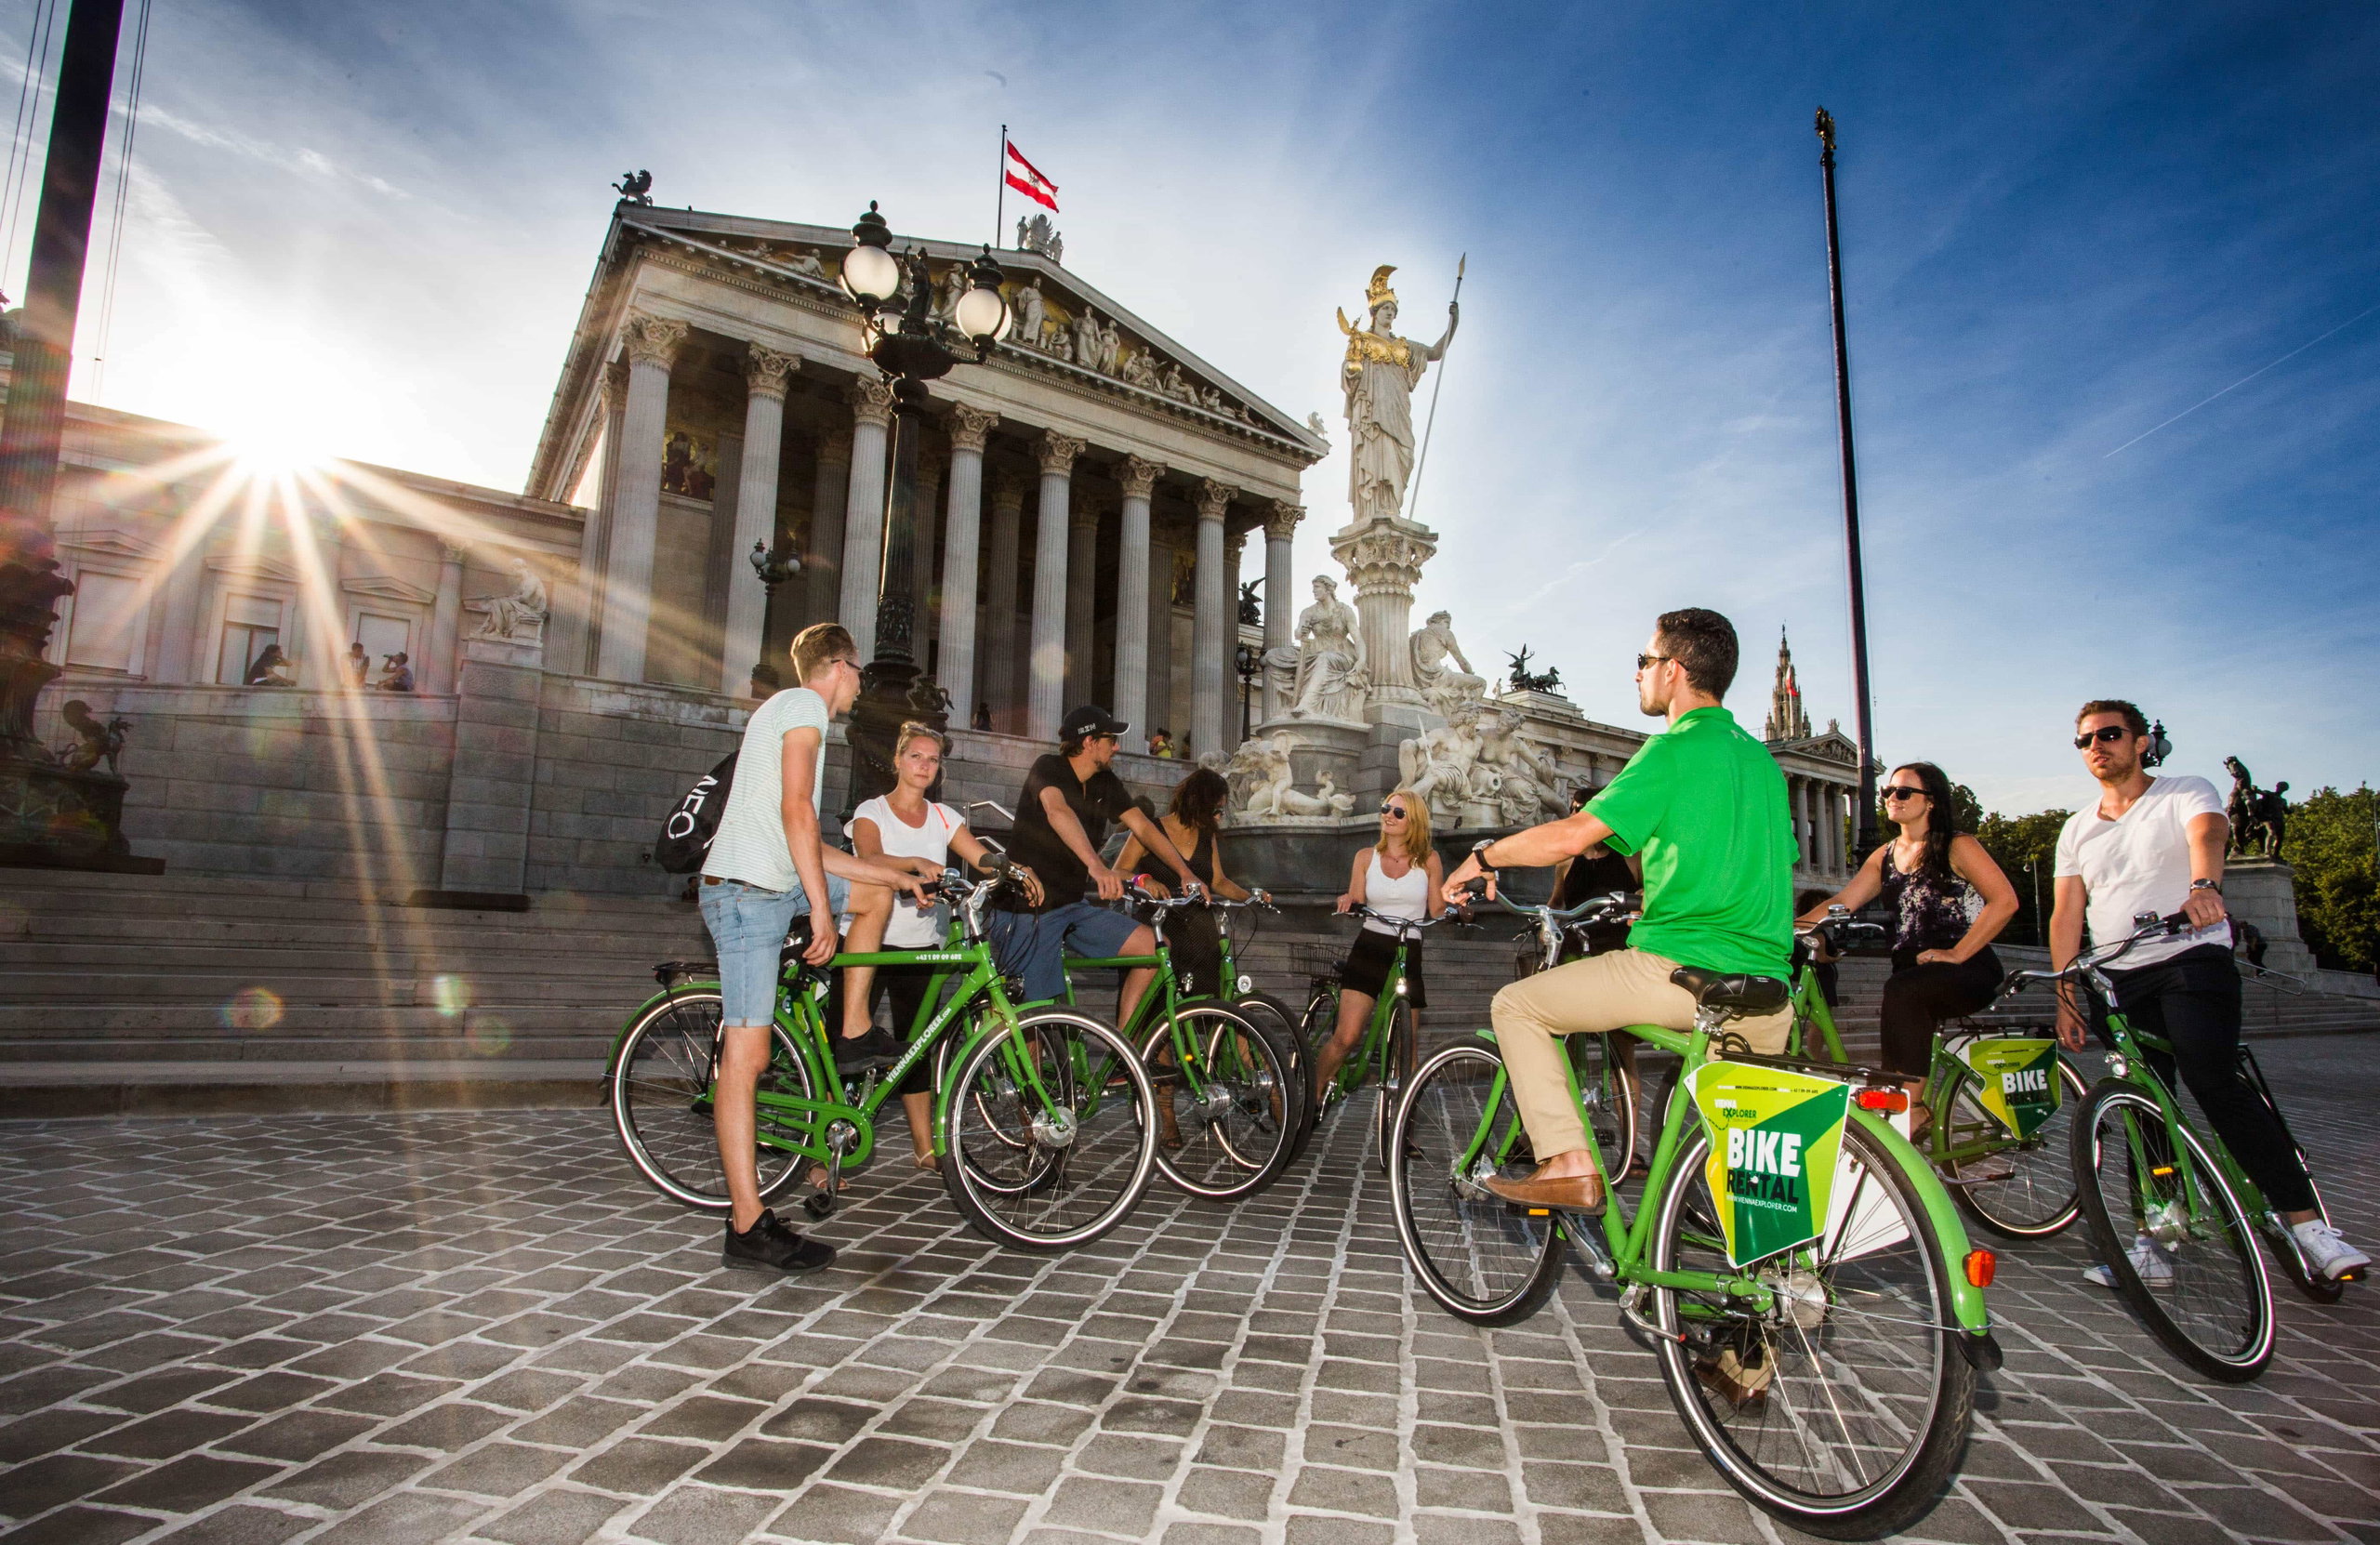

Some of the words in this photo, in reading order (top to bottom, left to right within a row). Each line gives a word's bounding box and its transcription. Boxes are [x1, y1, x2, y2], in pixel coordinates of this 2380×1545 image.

[2002, 1069, 2047, 1093] BIKE
[1723, 1107, 1756, 1118] EXPLORER
[1727, 1128, 1801, 1177] BIKE
[1726, 1169, 1799, 1204] RENTAL
[1726, 1195, 1798, 1213] WWW.VIENNAEXPLORER.COM
